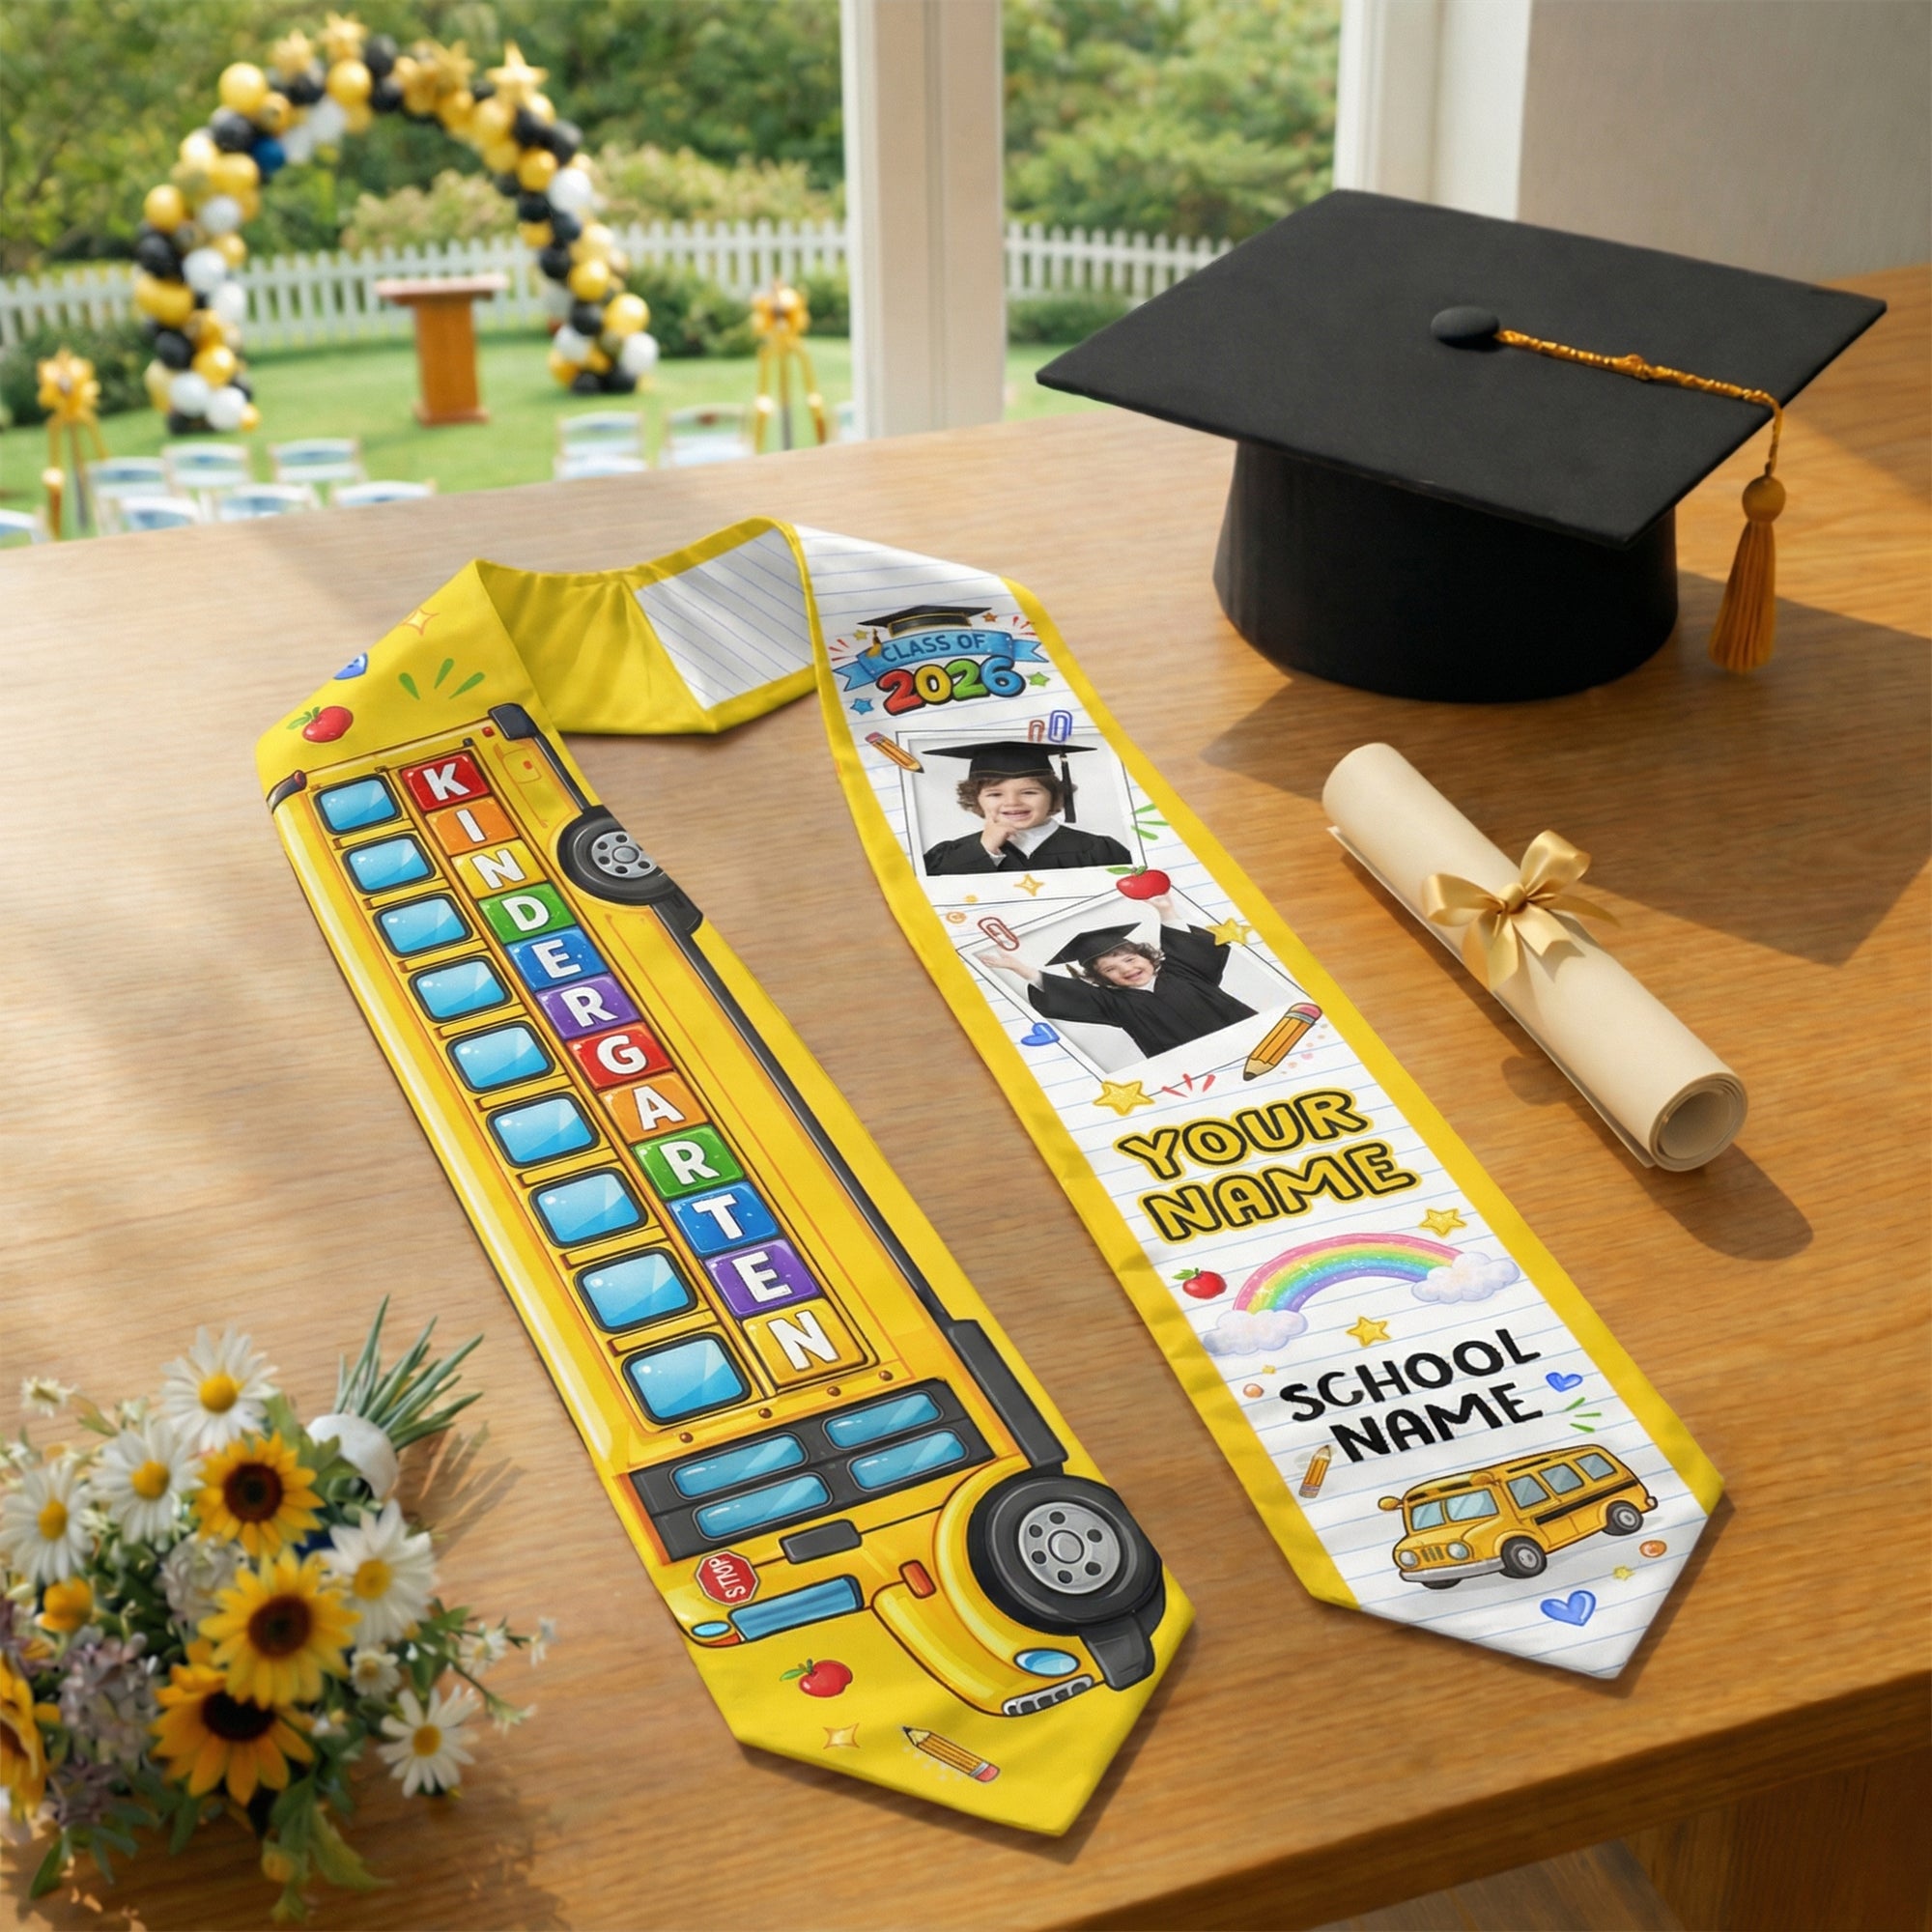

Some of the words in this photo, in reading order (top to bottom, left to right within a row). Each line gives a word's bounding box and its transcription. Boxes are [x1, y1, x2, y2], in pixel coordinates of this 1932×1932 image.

[875, 656, 1026, 716] 2026
[880, 635, 951, 663] CLASS
[957, 634, 986, 650] OF
[420, 760, 838, 1372] KINDERGARTEN
[1118, 1090, 1369, 1179] YOUR
[1143, 1145, 1417, 1242] NAME
[1280, 1329, 1542, 1422] SCHOOL
[1329, 1382, 1544, 1463] NAME
